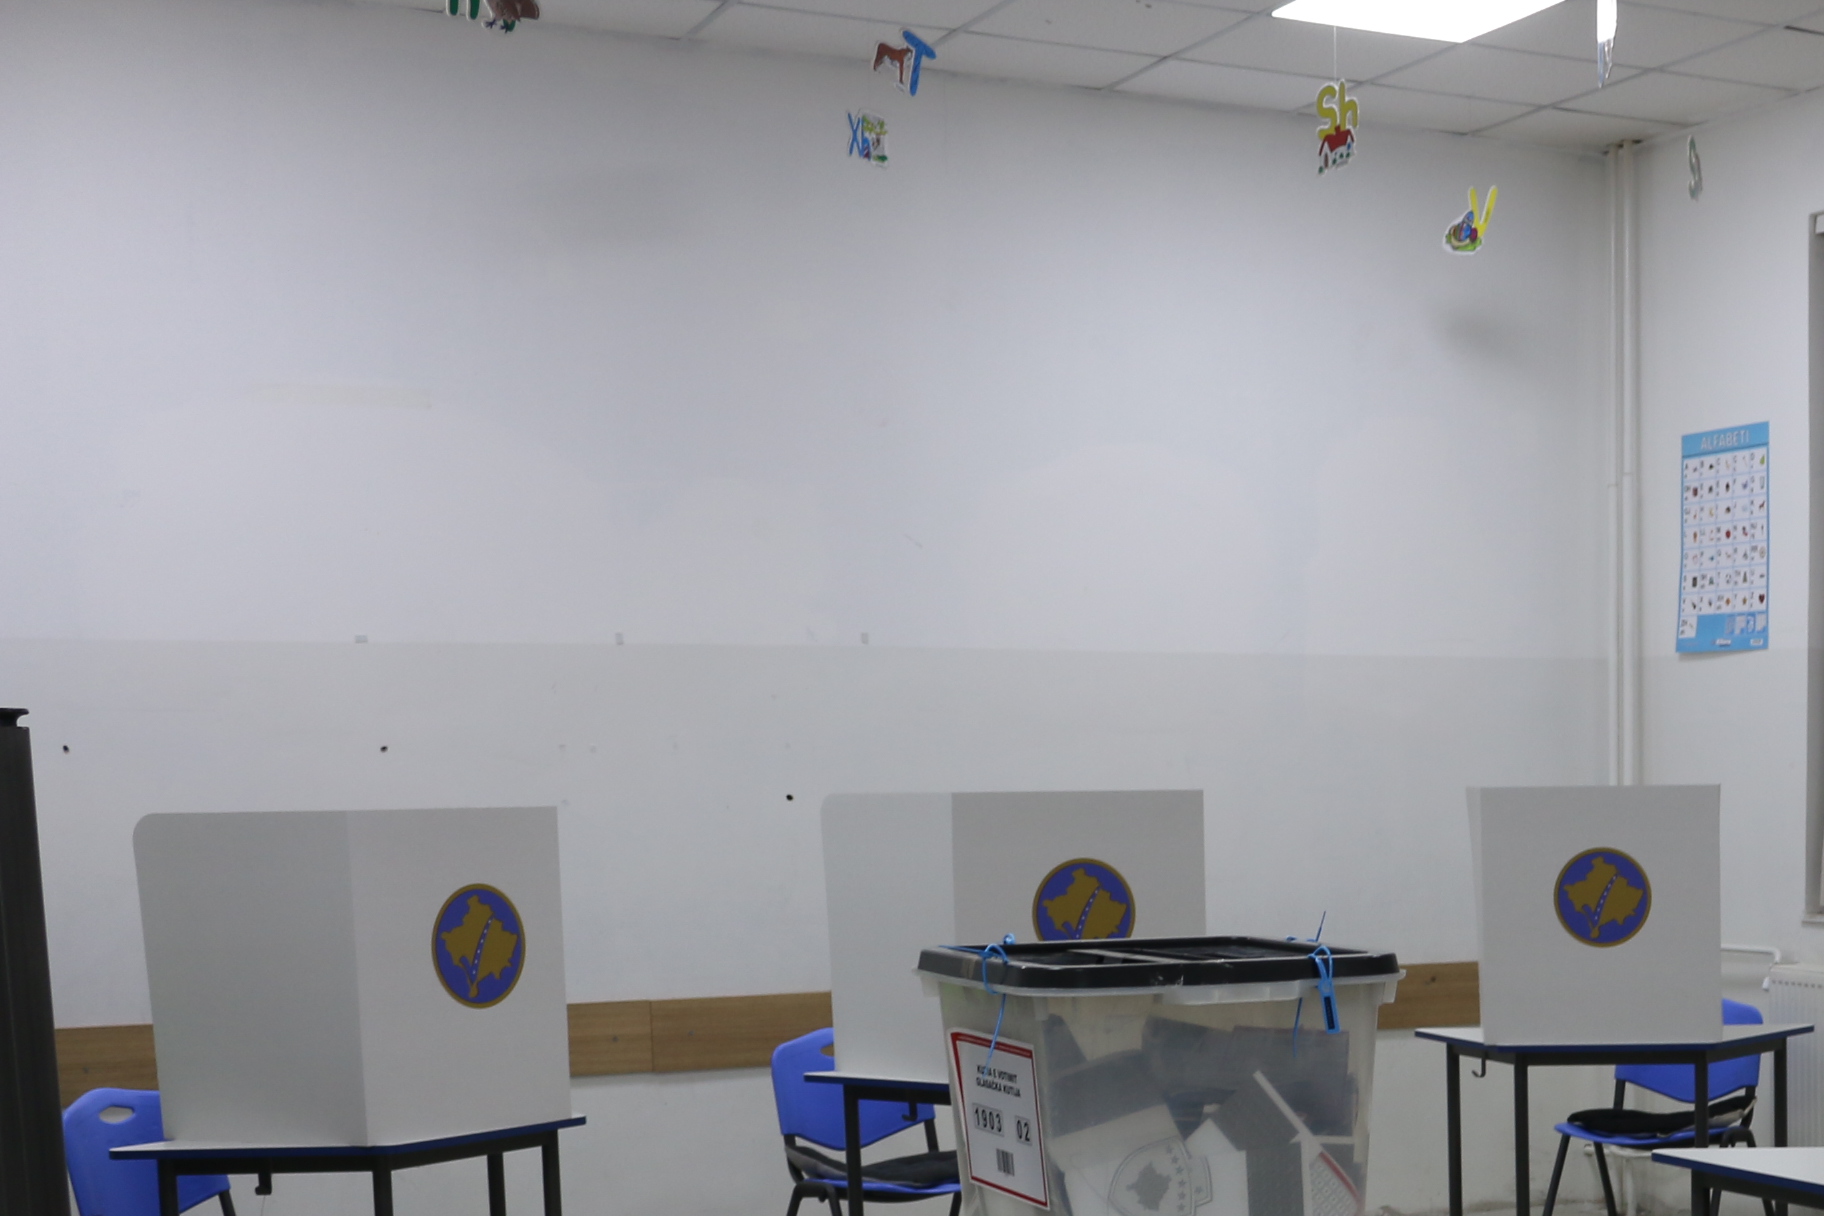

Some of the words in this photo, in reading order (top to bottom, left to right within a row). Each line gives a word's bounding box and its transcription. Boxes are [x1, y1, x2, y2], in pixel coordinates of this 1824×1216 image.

[1316, 81, 1358, 140] Sh
[1701, 430, 1750, 450] ALFABETI
[975, 1107, 1002, 1132] 1903
[1016, 1119, 1030, 1142] 02
